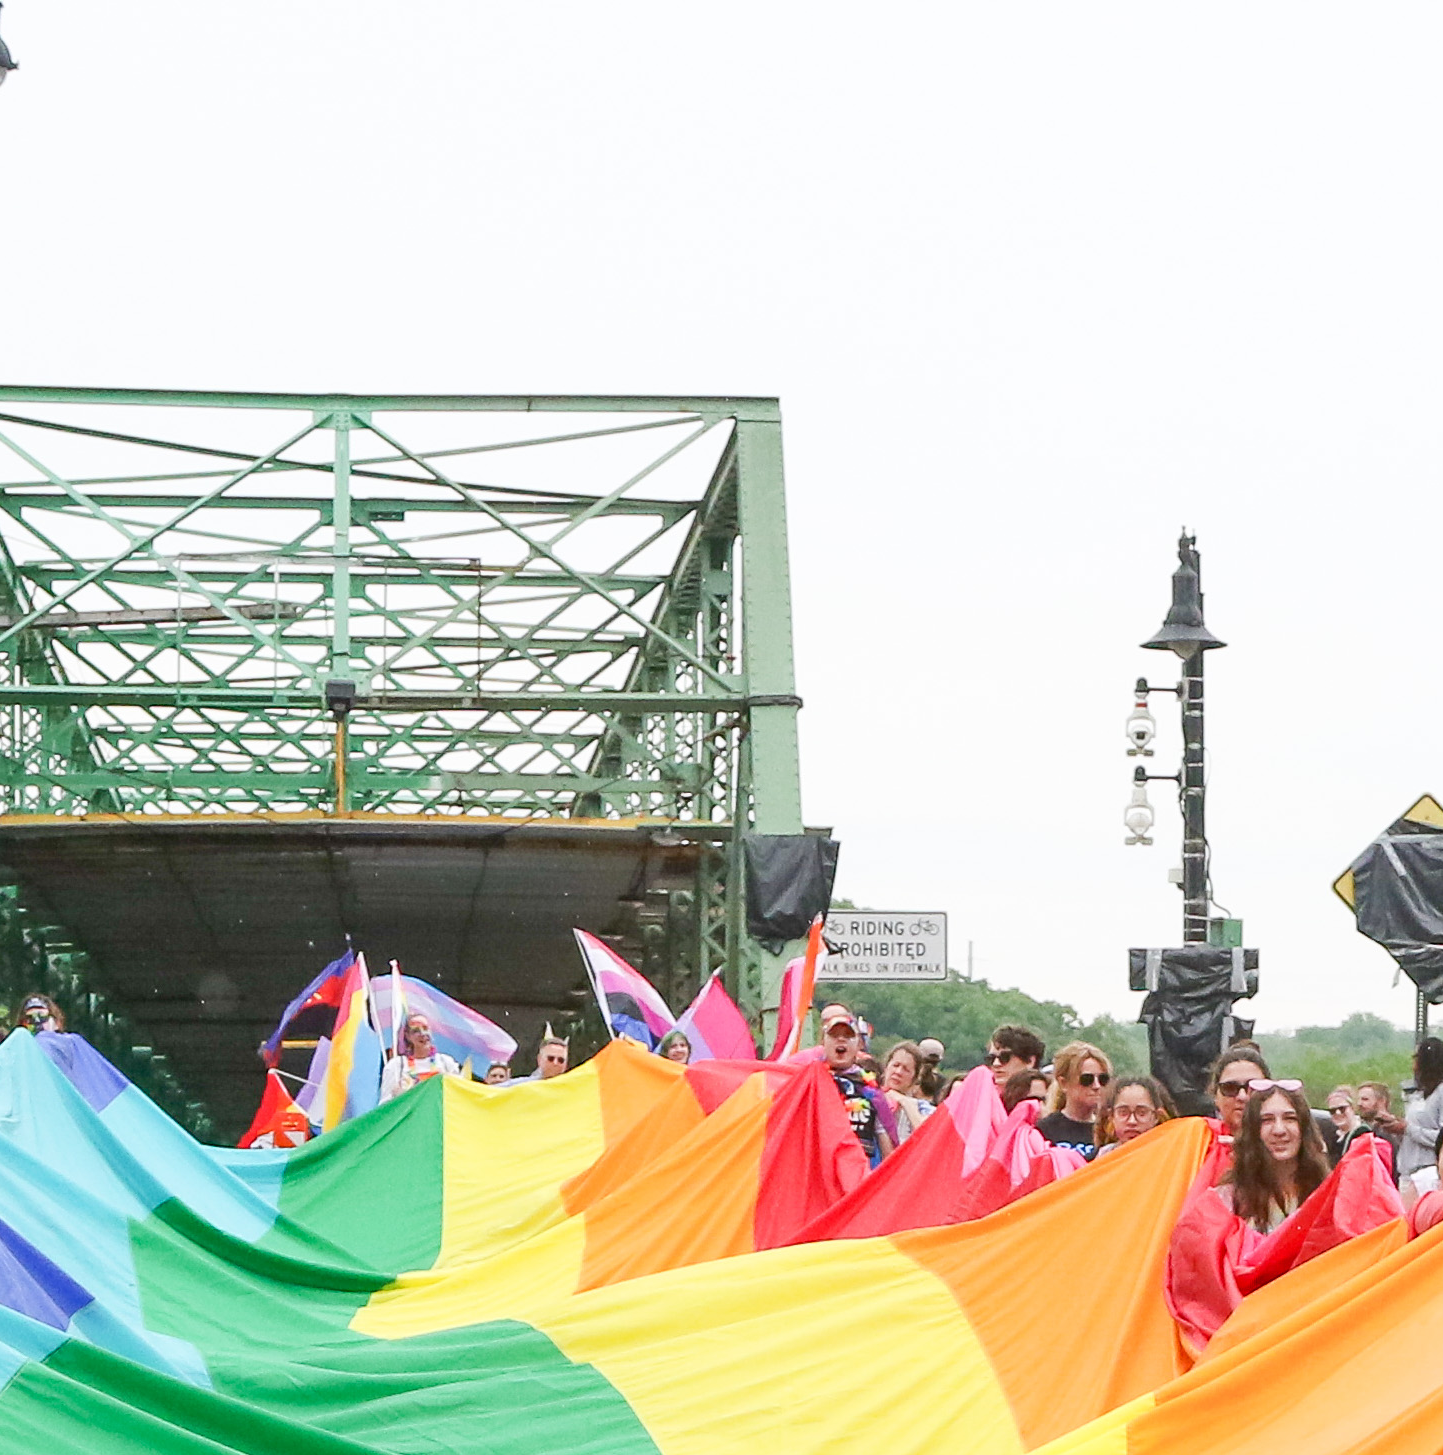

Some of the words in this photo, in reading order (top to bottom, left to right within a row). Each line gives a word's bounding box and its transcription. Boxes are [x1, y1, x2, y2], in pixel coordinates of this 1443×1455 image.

[850, 921, 904, 935] RIDING
[822, 963, 839, 973] ALK
[845, 963, 869, 972] BIKES
[877, 963, 888, 972] ON
[893, 963, 941, 972] FOOTWALK
